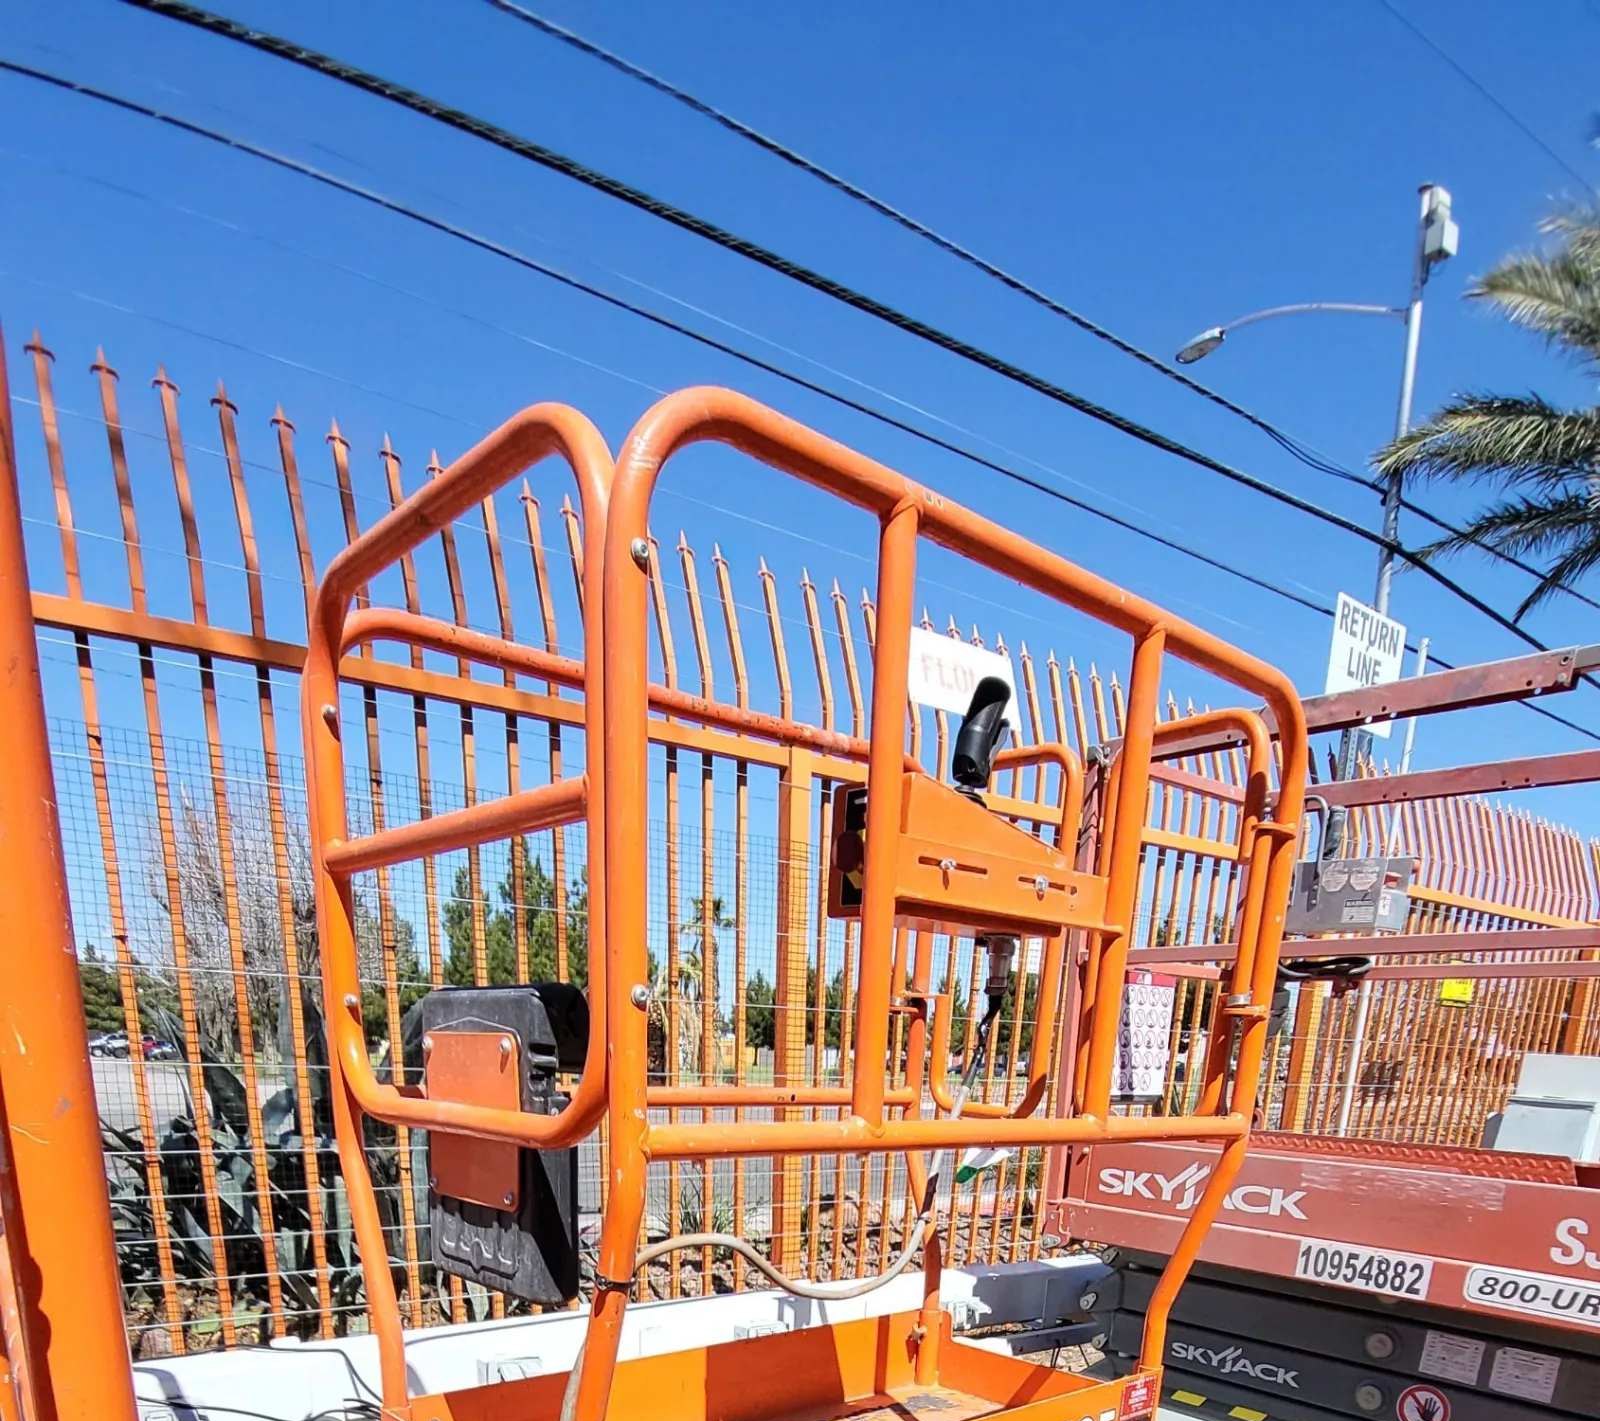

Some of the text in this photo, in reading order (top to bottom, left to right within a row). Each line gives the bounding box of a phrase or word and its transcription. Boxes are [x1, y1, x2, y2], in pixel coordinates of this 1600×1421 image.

[1339, 599, 1400, 658] RETURN
[1346, 646, 1382, 686] LINE
[1300, 1244, 1425, 1296] 10954882
[1171, 1341, 1300, 1389] SKYJACK
